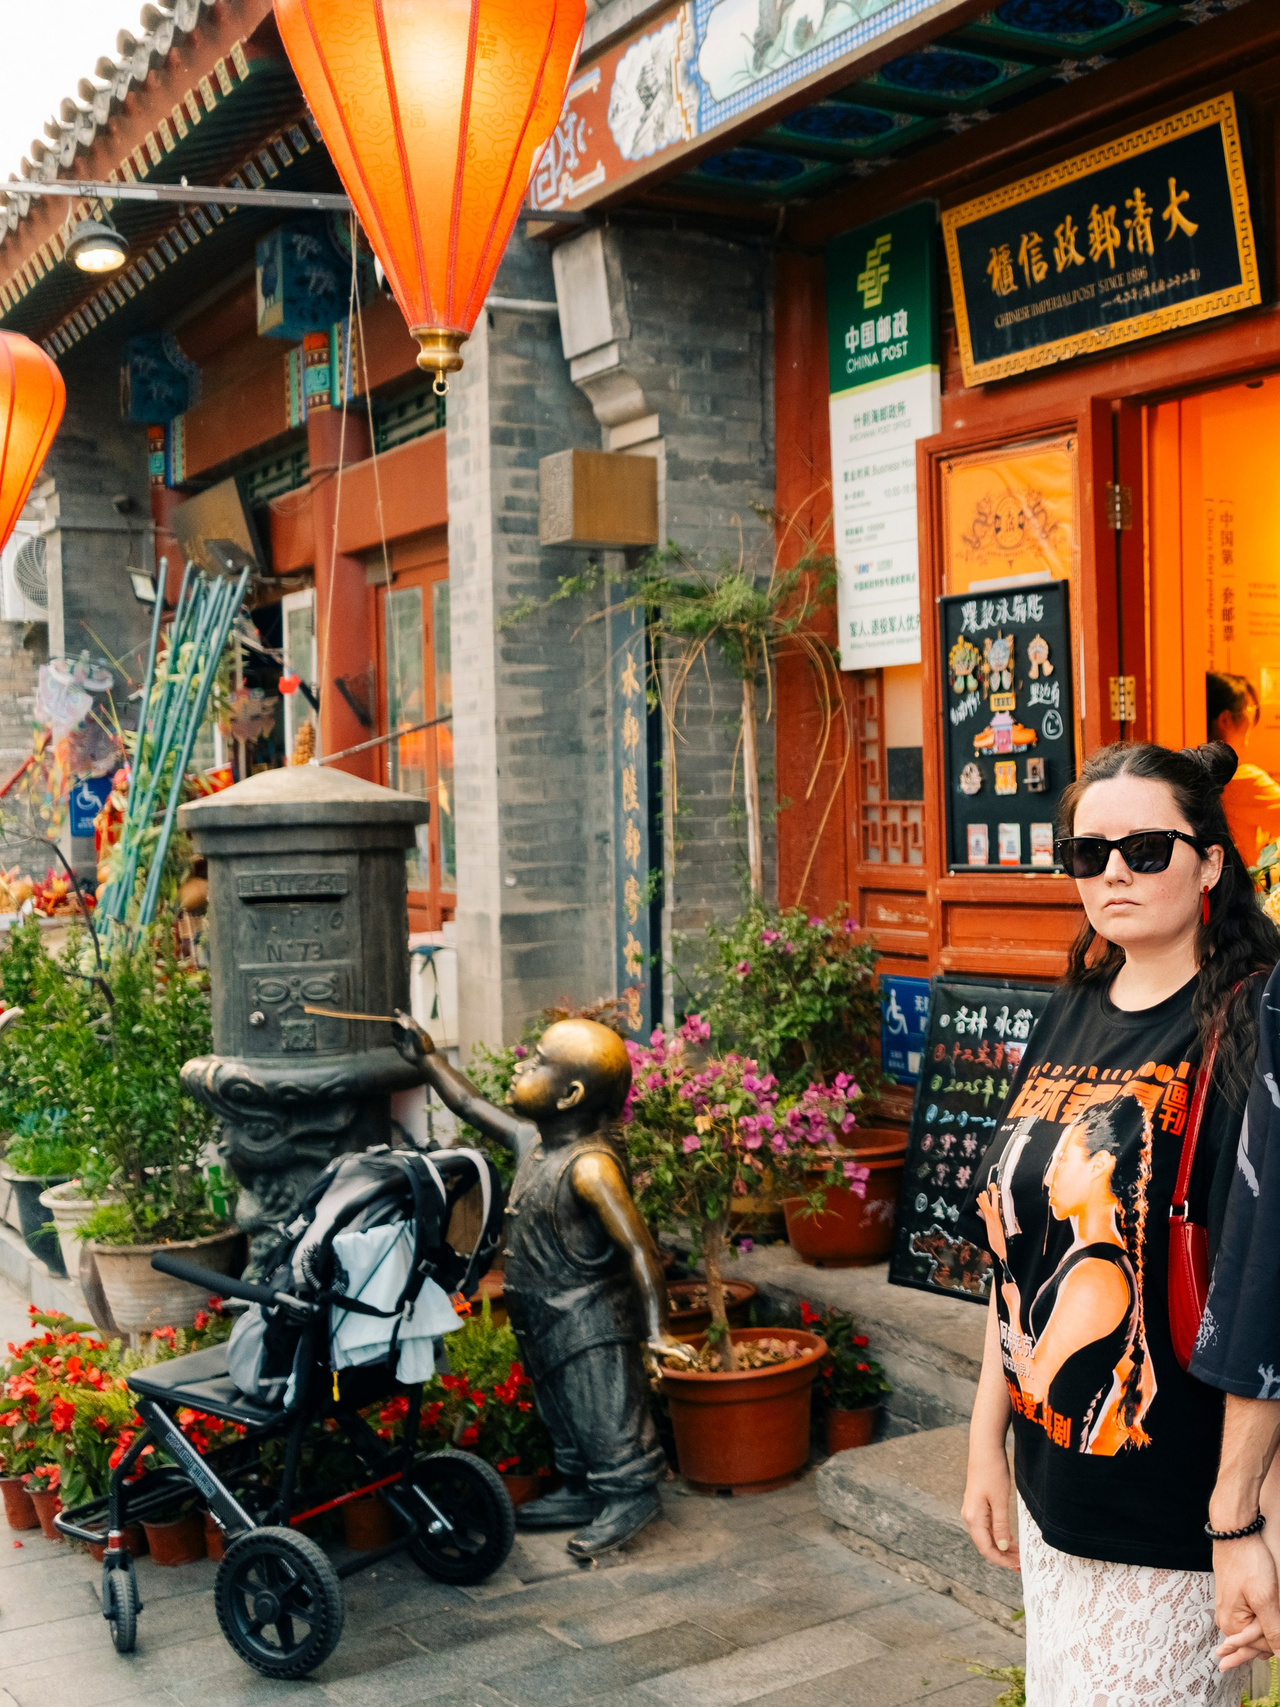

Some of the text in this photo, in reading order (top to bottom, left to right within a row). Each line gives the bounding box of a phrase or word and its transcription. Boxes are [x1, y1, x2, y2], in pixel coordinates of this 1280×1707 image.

[844, 307, 909, 355] 中国邮政
[846, 339, 909, 374] CHINA POST
